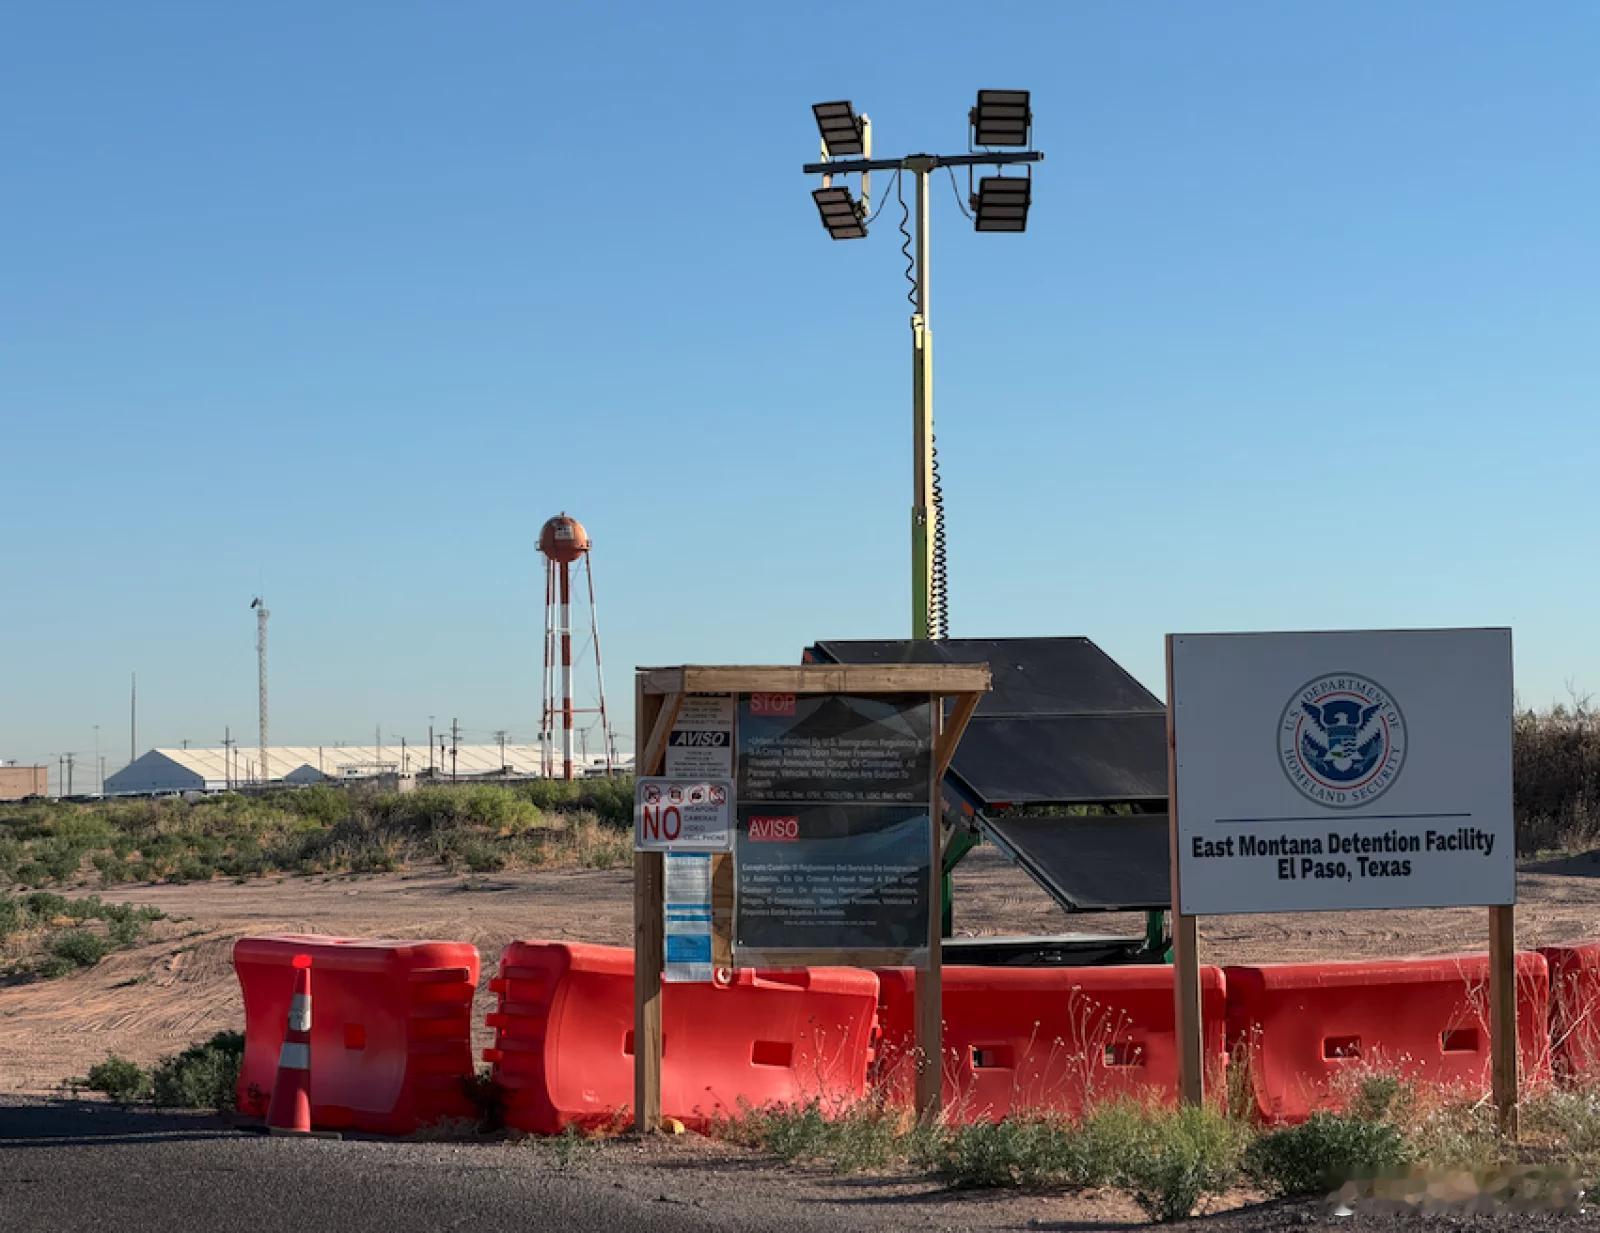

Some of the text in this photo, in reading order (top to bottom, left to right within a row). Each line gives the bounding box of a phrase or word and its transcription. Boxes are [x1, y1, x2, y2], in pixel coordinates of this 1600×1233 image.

[751, 694, 796, 711] STOP
[1302, 678, 1391, 712] DEPARTMENT
[1387, 710, 1401, 730] OF
[675, 732, 725, 746] AVISO
[1284, 745, 1401, 803] HOMELAND SECURITY
[642, 805, 682, 841] NO
[748, 819, 798, 837] AVISO
[1191, 827, 1496, 859] East Montana Detention Facility
[1278, 856, 1411, 882] El Paso, Texas
